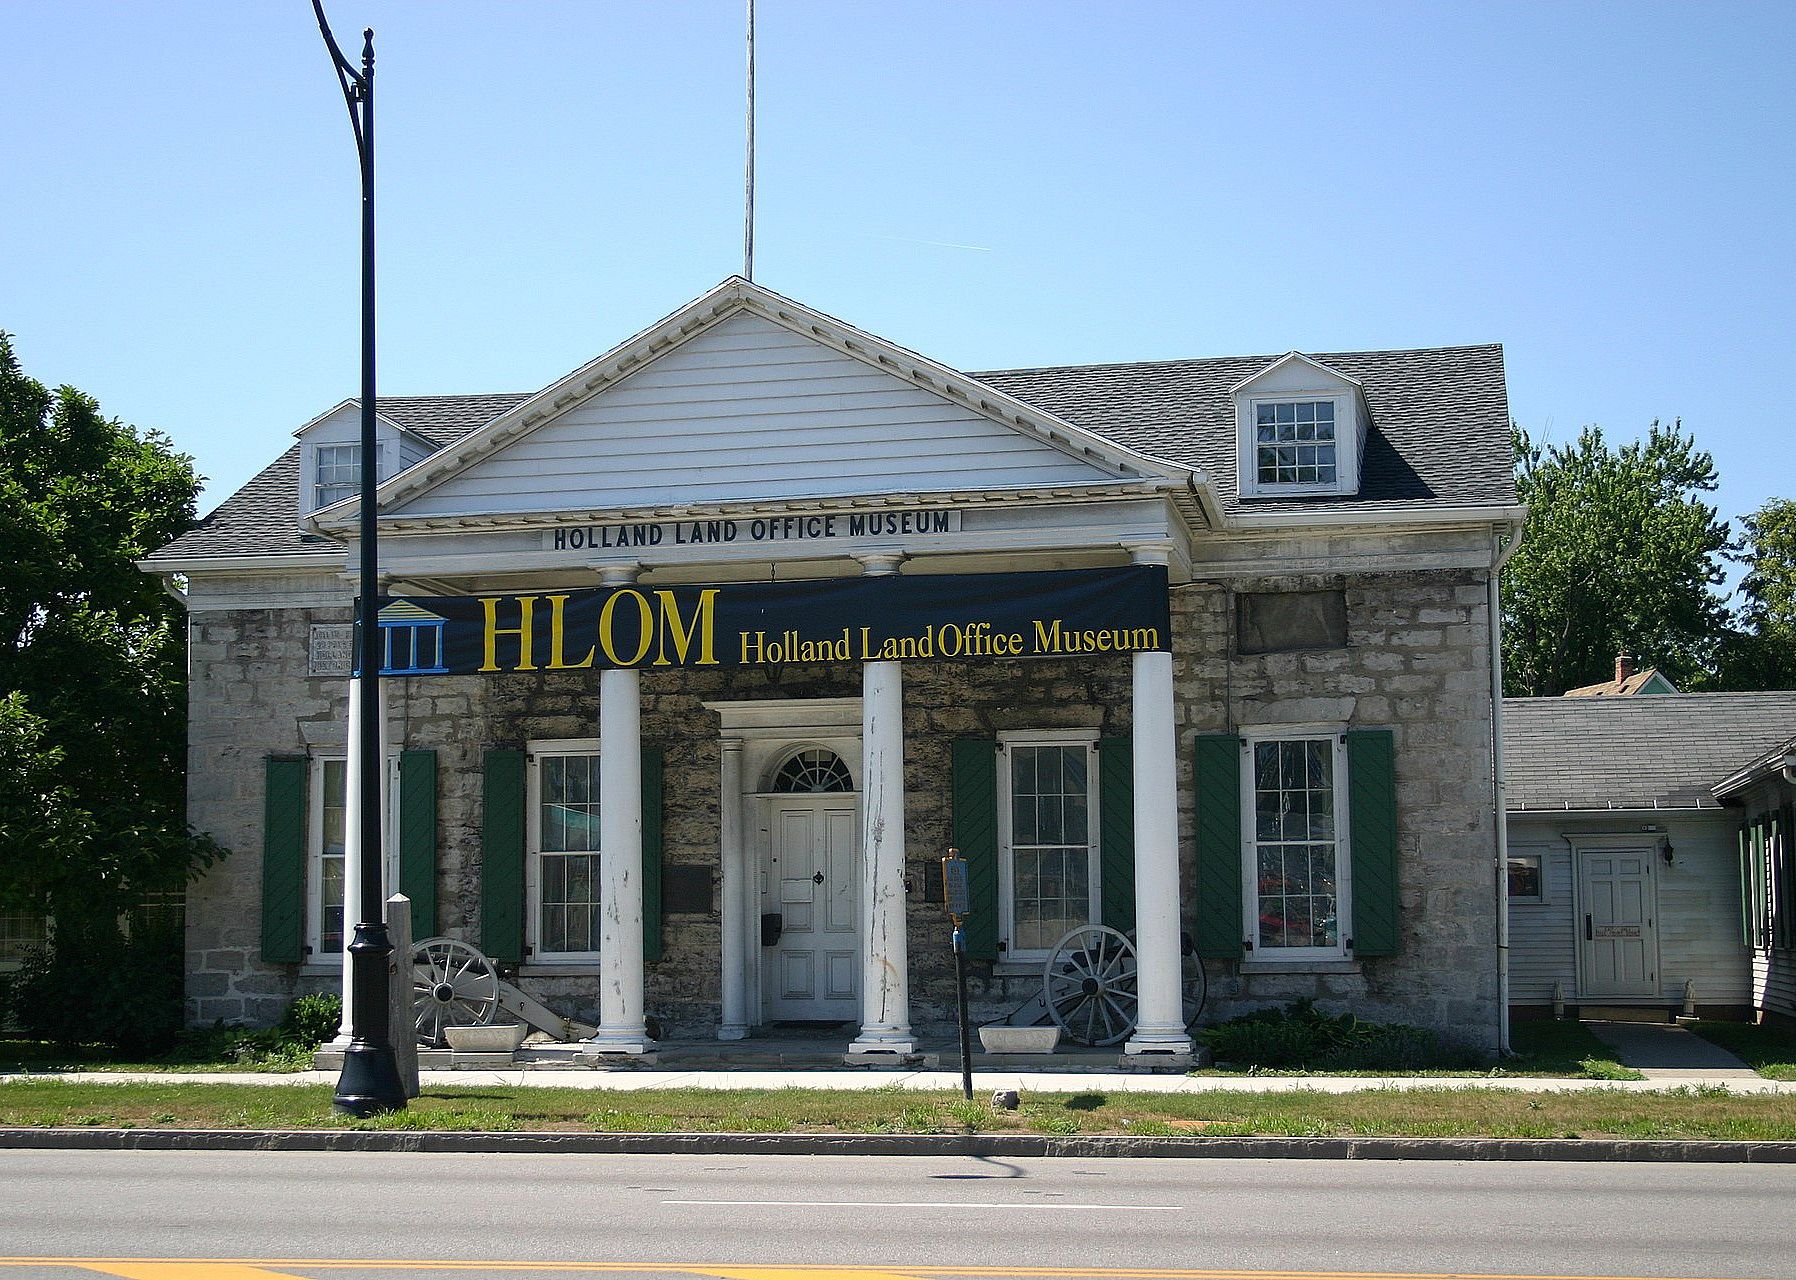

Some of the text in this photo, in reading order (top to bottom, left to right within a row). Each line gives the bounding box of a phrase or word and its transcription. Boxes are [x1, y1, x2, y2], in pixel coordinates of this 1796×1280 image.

[554, 510, 950, 551] HOLLAND LAND OFFICE MUSEUM
[477, 589, 721, 672] HLOM
[739, 618, 1160, 664] Holland Land Office Museum
